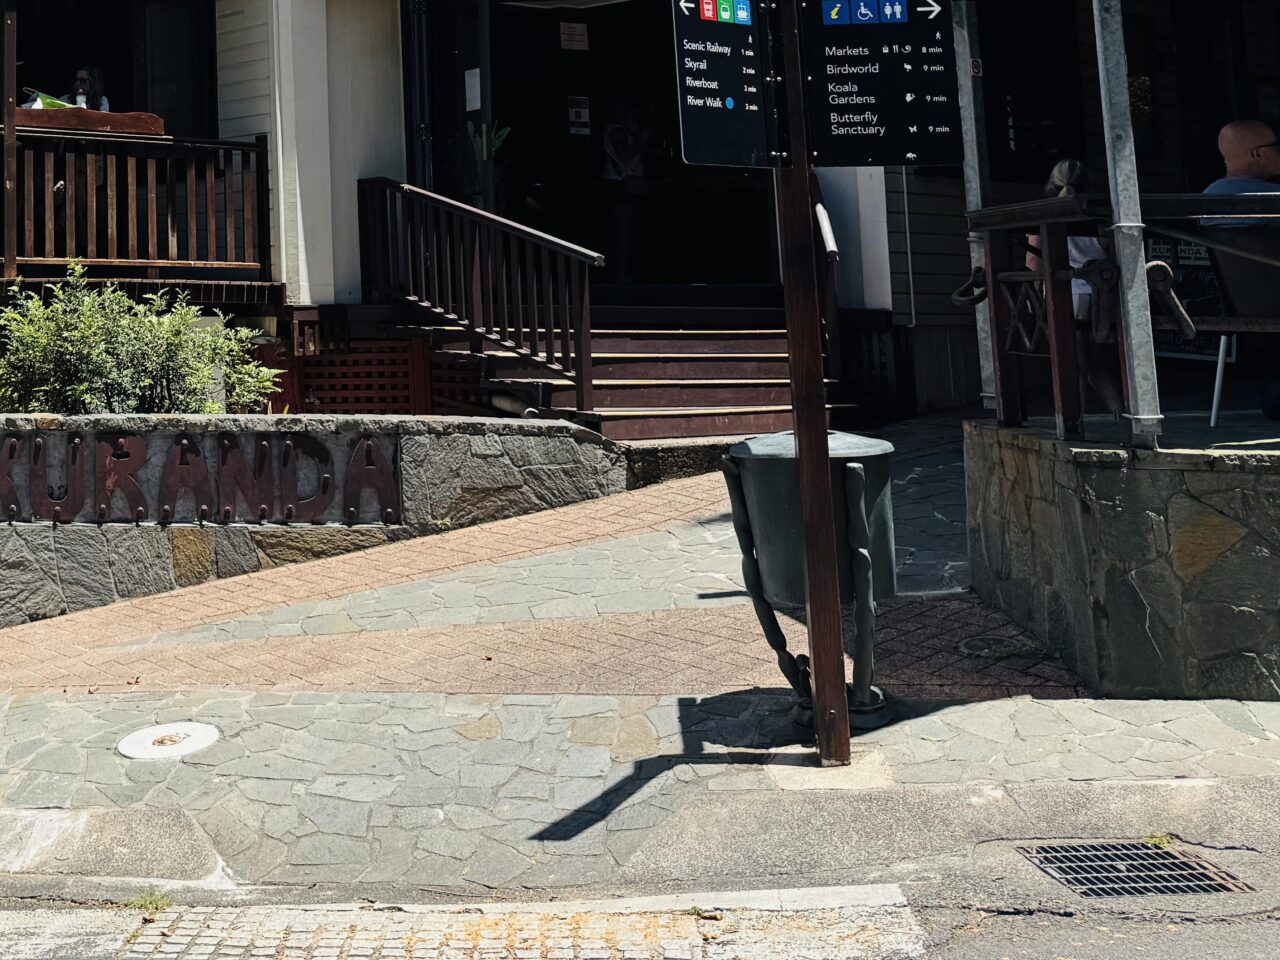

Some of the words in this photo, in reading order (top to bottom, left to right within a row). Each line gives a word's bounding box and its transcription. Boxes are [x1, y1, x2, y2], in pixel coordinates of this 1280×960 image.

[683, 39, 705, 51] Scenic
[706, 42, 731, 56] Railway
[825, 45, 869, 56] Markets
[684, 58, 707, 71] Skyrail
[826, 63, 879, 74] Birdworld
[686, 76, 719, 89] Riverboat
[828, 82, 858, 92] Koala
[687, 95, 704, 106] River
[705, 96, 723, 108] Walk
[829, 94, 876, 104] Gardens
[830, 111, 878, 124] Butterfly
[831, 125, 886, 137] Sanctuary
